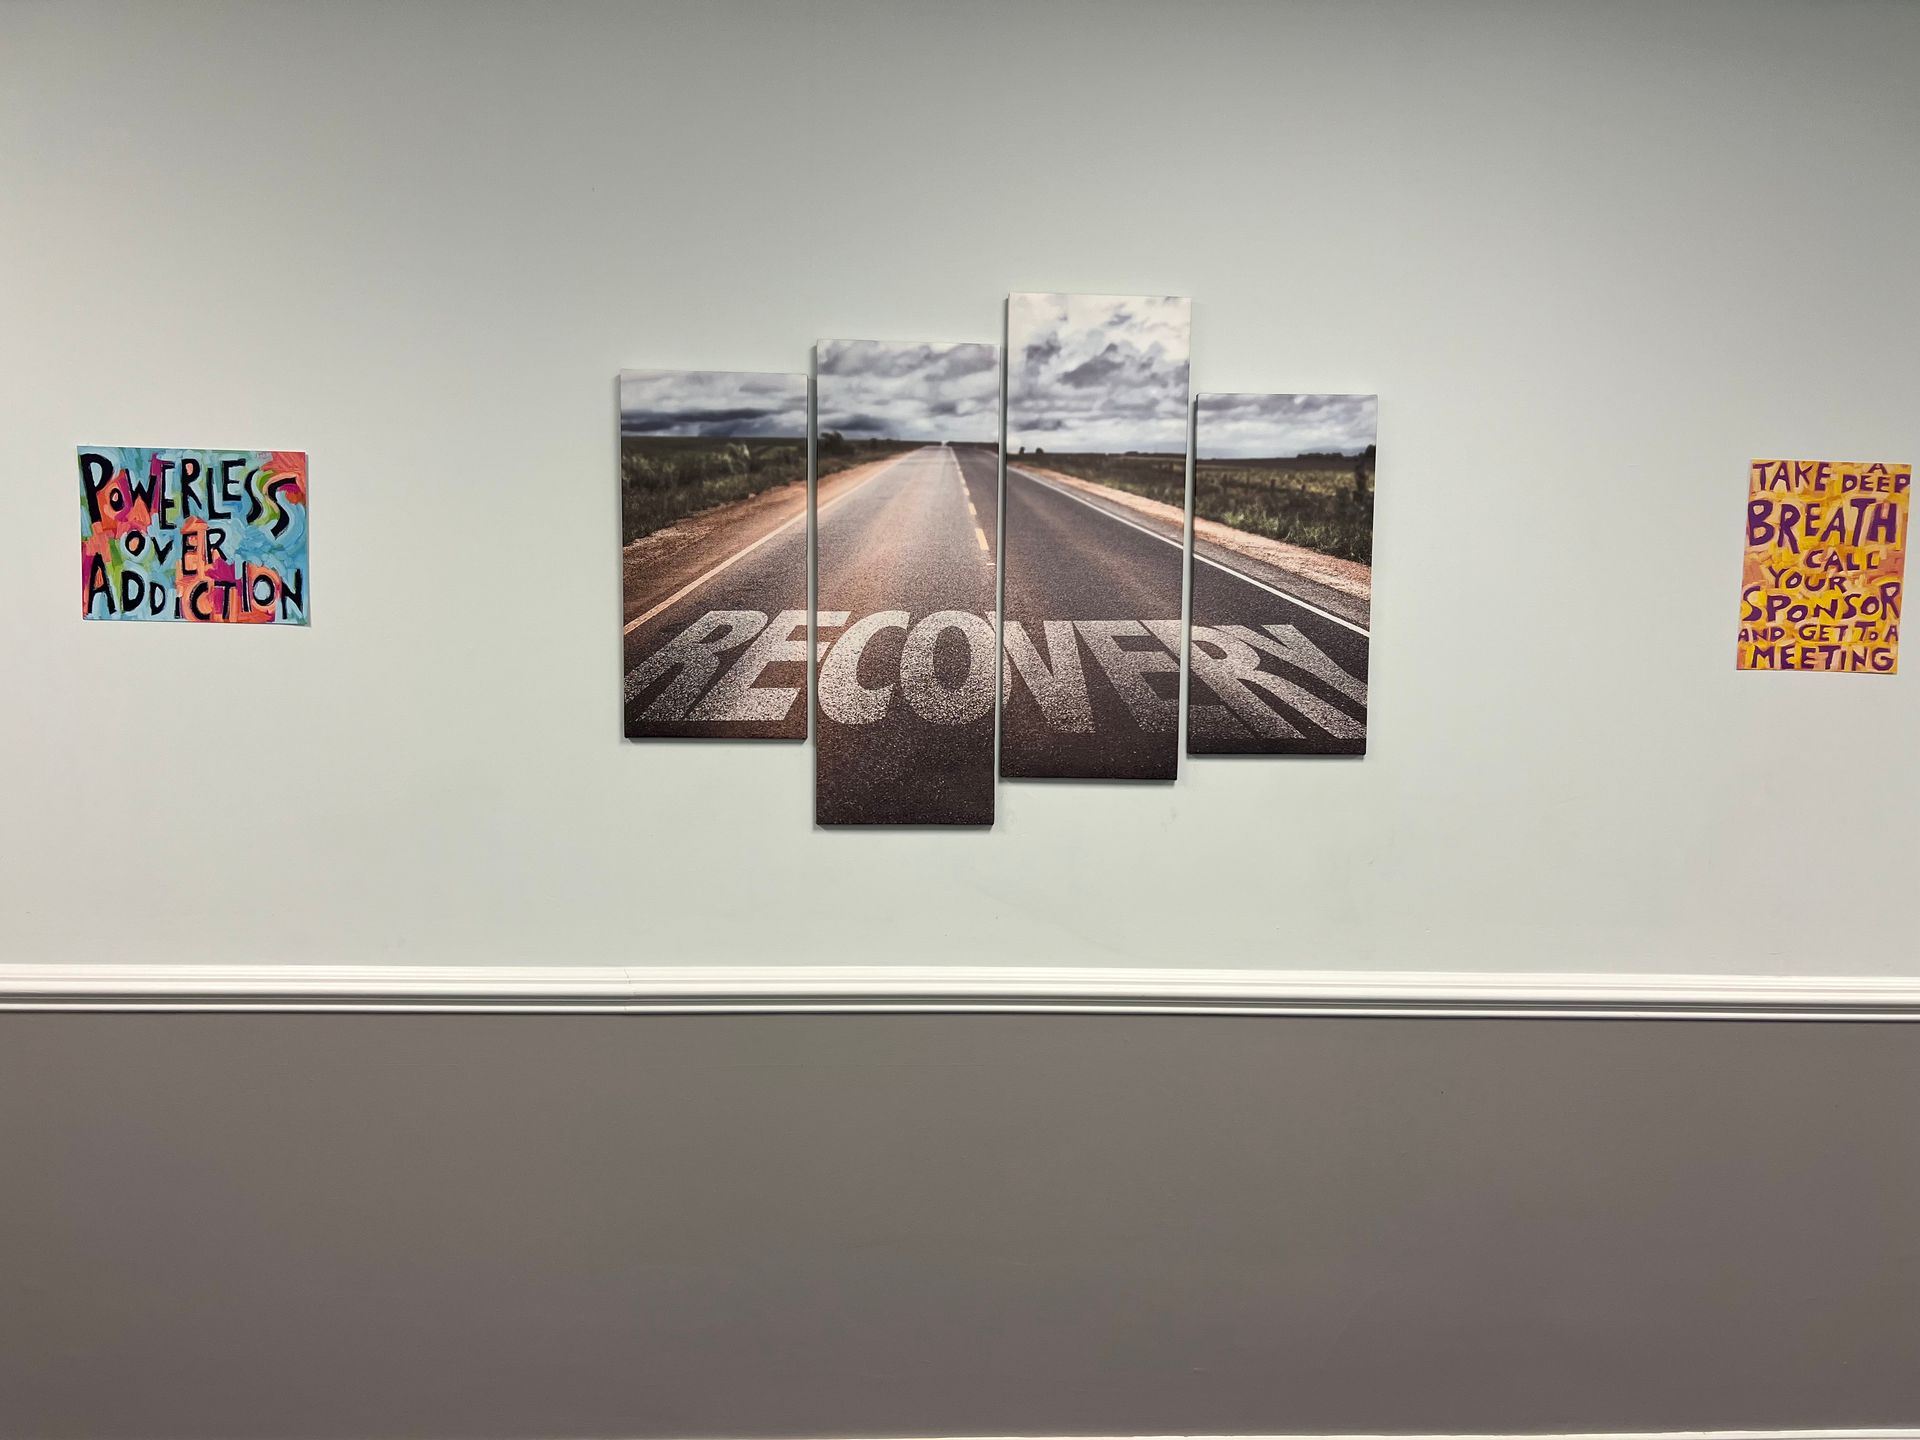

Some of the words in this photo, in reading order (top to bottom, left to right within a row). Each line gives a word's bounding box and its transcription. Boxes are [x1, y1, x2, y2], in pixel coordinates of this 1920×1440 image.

[1752, 461, 1831, 491] TAKE
[1841, 474, 1911, 493] DEEP
[1868, 463, 1888, 474] A
[80, 453, 299, 540] POWERLESS
[1748, 498, 1898, 554] BREATH
[125, 529, 228, 576] OVER
[1806, 550, 1880, 572] CALL
[88, 552, 303, 621] ADDICTION
[1768, 566, 1848, 593] YOUR
[1742, 582, 1902, 622] SPONSOR
[1738, 626, 1785, 642] AND
[1798, 624, 1848, 641] GET
[1855, 621, 1879, 640] TO
[1885, 624, 1899, 642] A
[1751, 645, 1895, 670] MEETING
[624, 610, 1368, 740] RECOVERY
